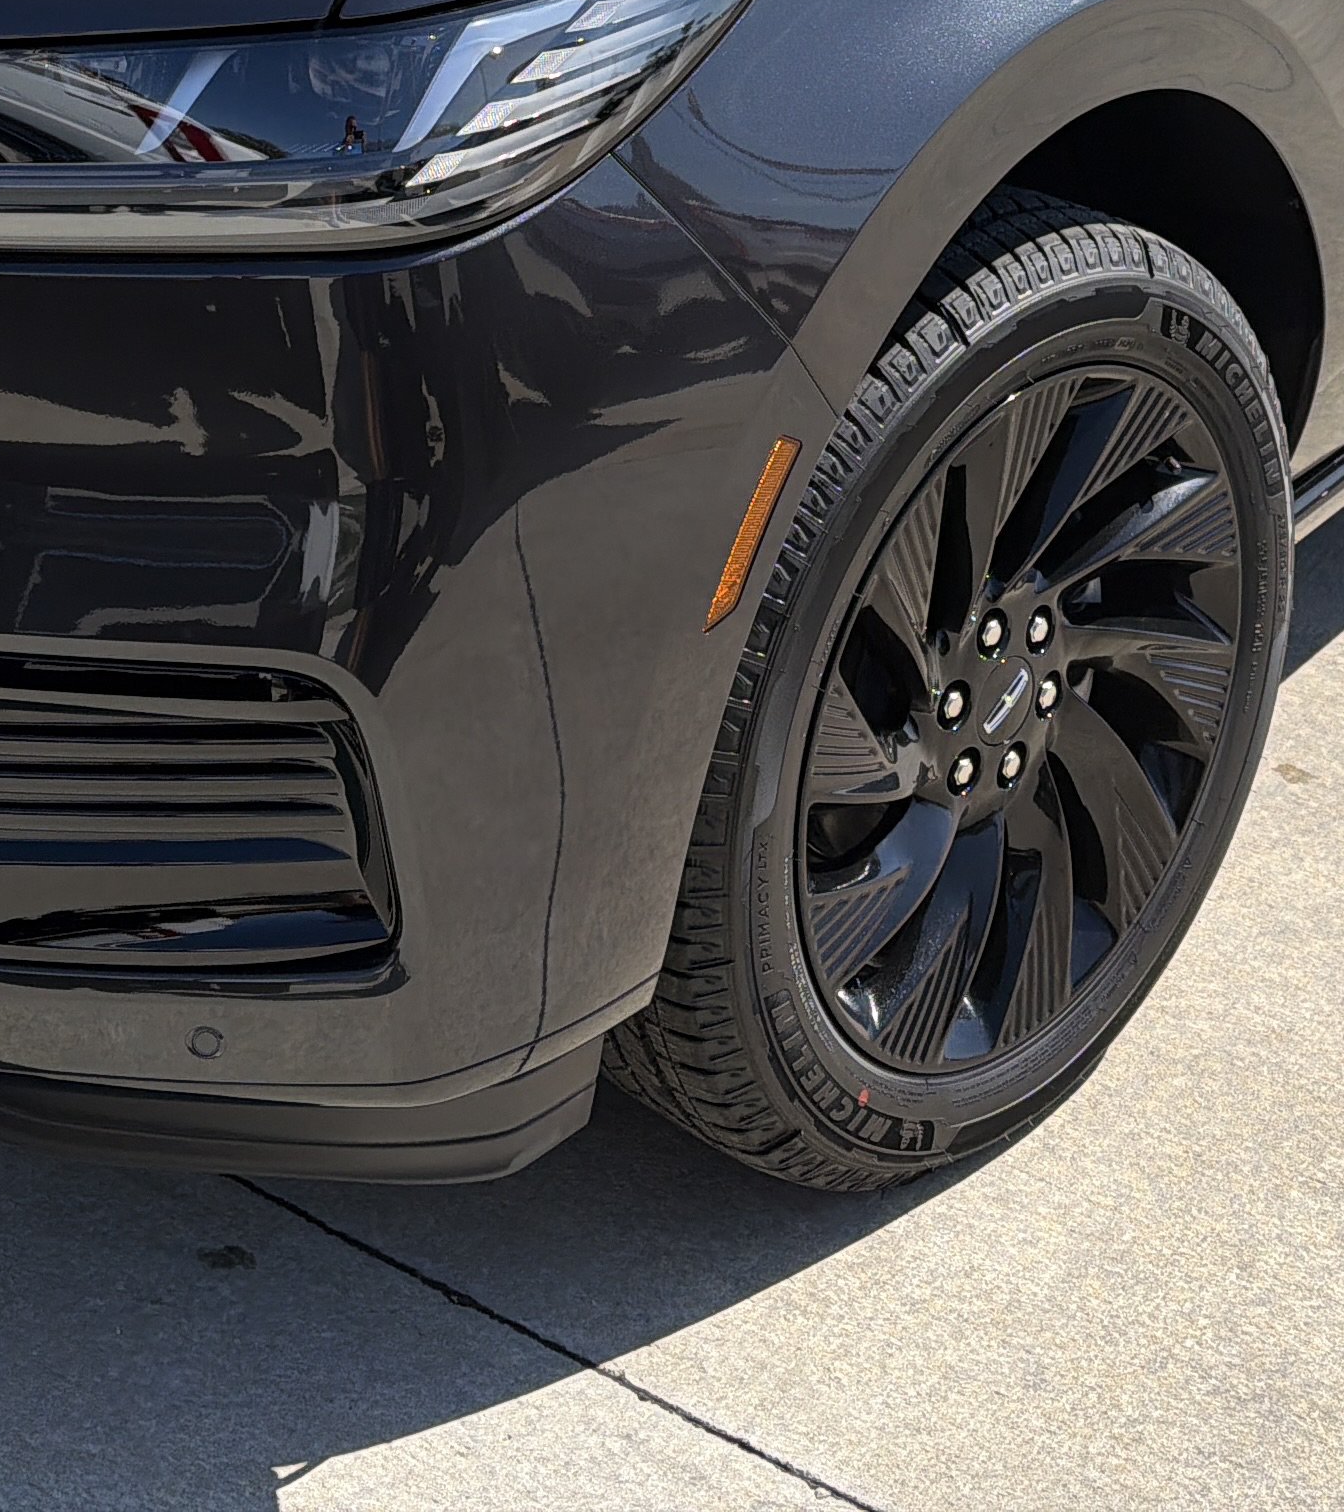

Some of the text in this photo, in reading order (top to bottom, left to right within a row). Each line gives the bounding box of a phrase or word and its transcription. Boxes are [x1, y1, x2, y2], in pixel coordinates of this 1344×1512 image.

[1195, 331, 1281, 487] MICHELIN
[757, 841, 774, 975] PRIMACY LTX
[770, 999, 893, 1144] MICHELIN
